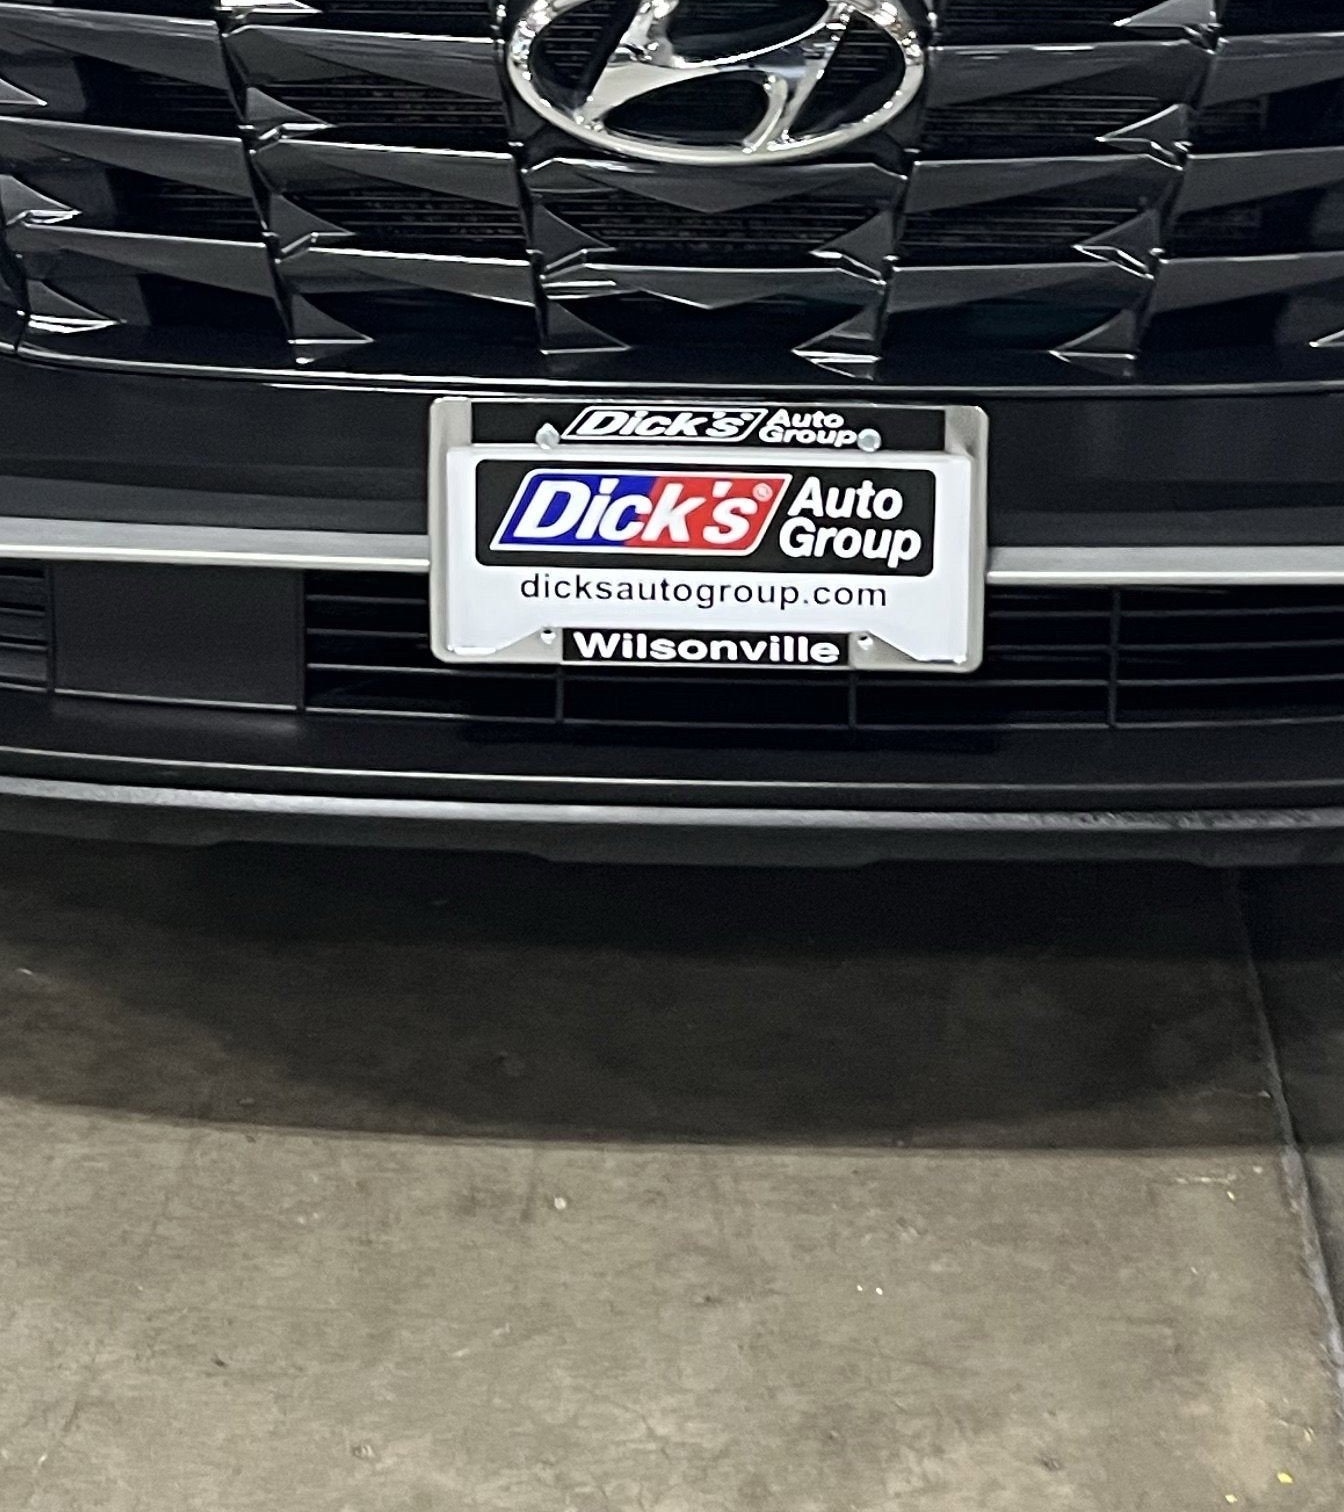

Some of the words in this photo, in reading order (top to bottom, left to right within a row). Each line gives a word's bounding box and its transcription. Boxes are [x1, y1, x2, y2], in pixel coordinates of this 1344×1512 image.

[575, 409, 745, 438] Dick's
[758, 425, 857, 448] Group
[766, 408, 845, 429] Auto
[512, 477, 759, 545] Dick's
[787, 476, 904, 520] Auto
[778, 517, 923, 569] Group
[520, 573, 888, 611] dicksautogroup.com
[572, 630, 841, 665] Wilsonville
